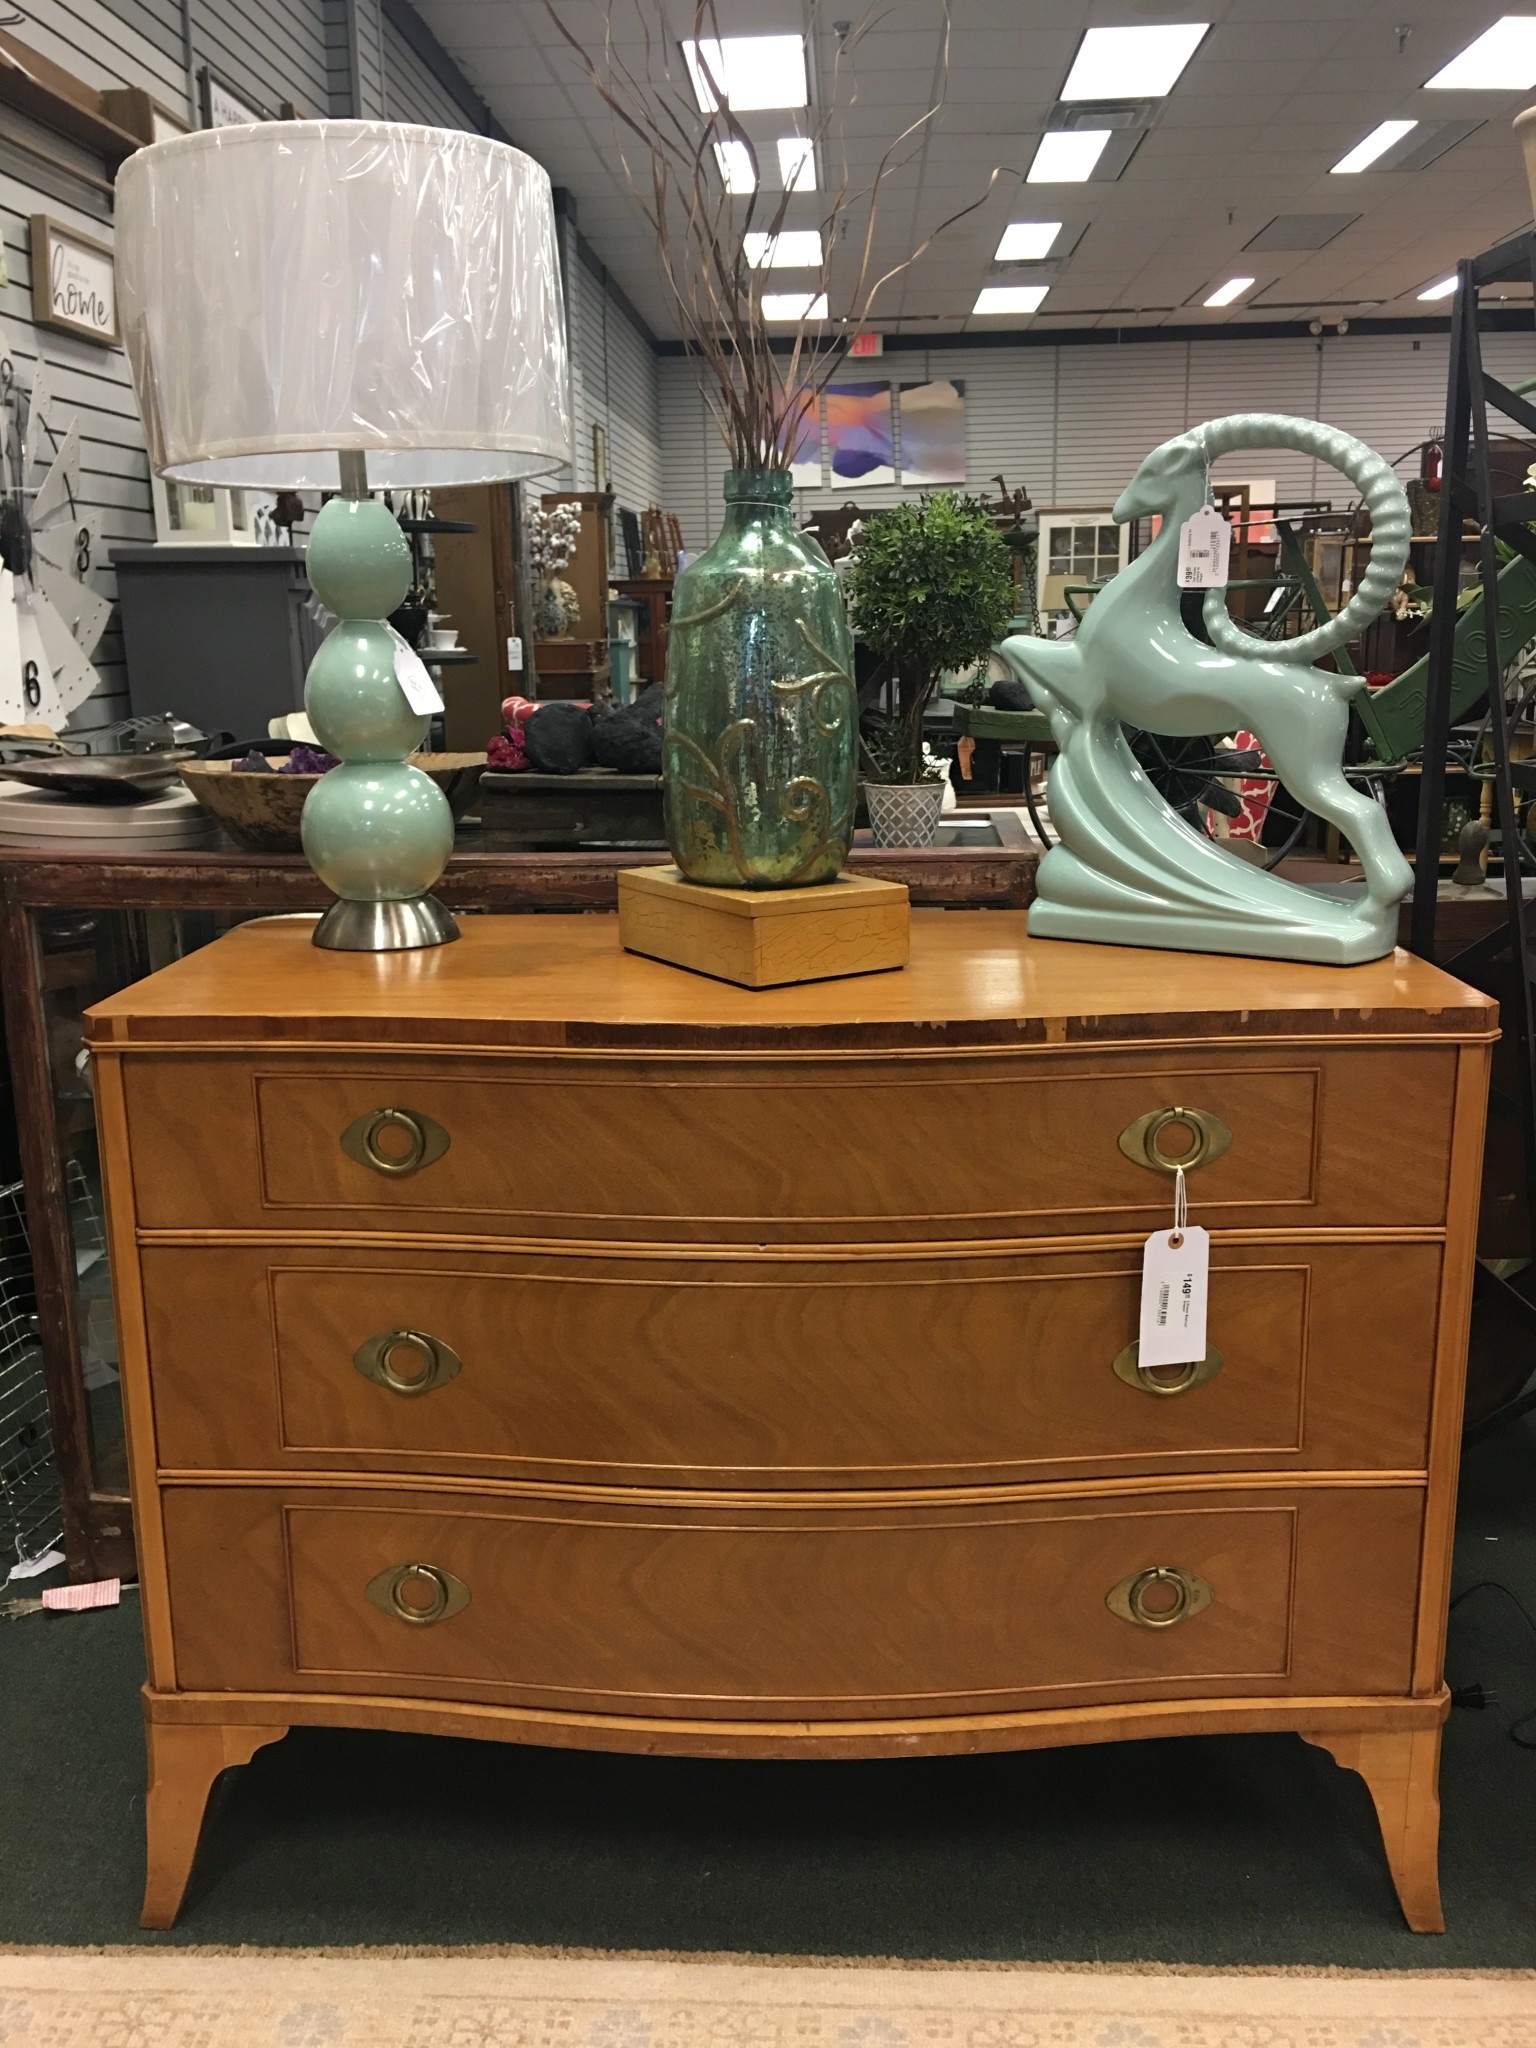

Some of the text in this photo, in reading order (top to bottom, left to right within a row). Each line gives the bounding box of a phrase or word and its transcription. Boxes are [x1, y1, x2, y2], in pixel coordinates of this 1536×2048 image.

[52, 244, 111, 326] home
[853, 334, 877, 355] EXIT
[25, 660, 41, 707] 6
